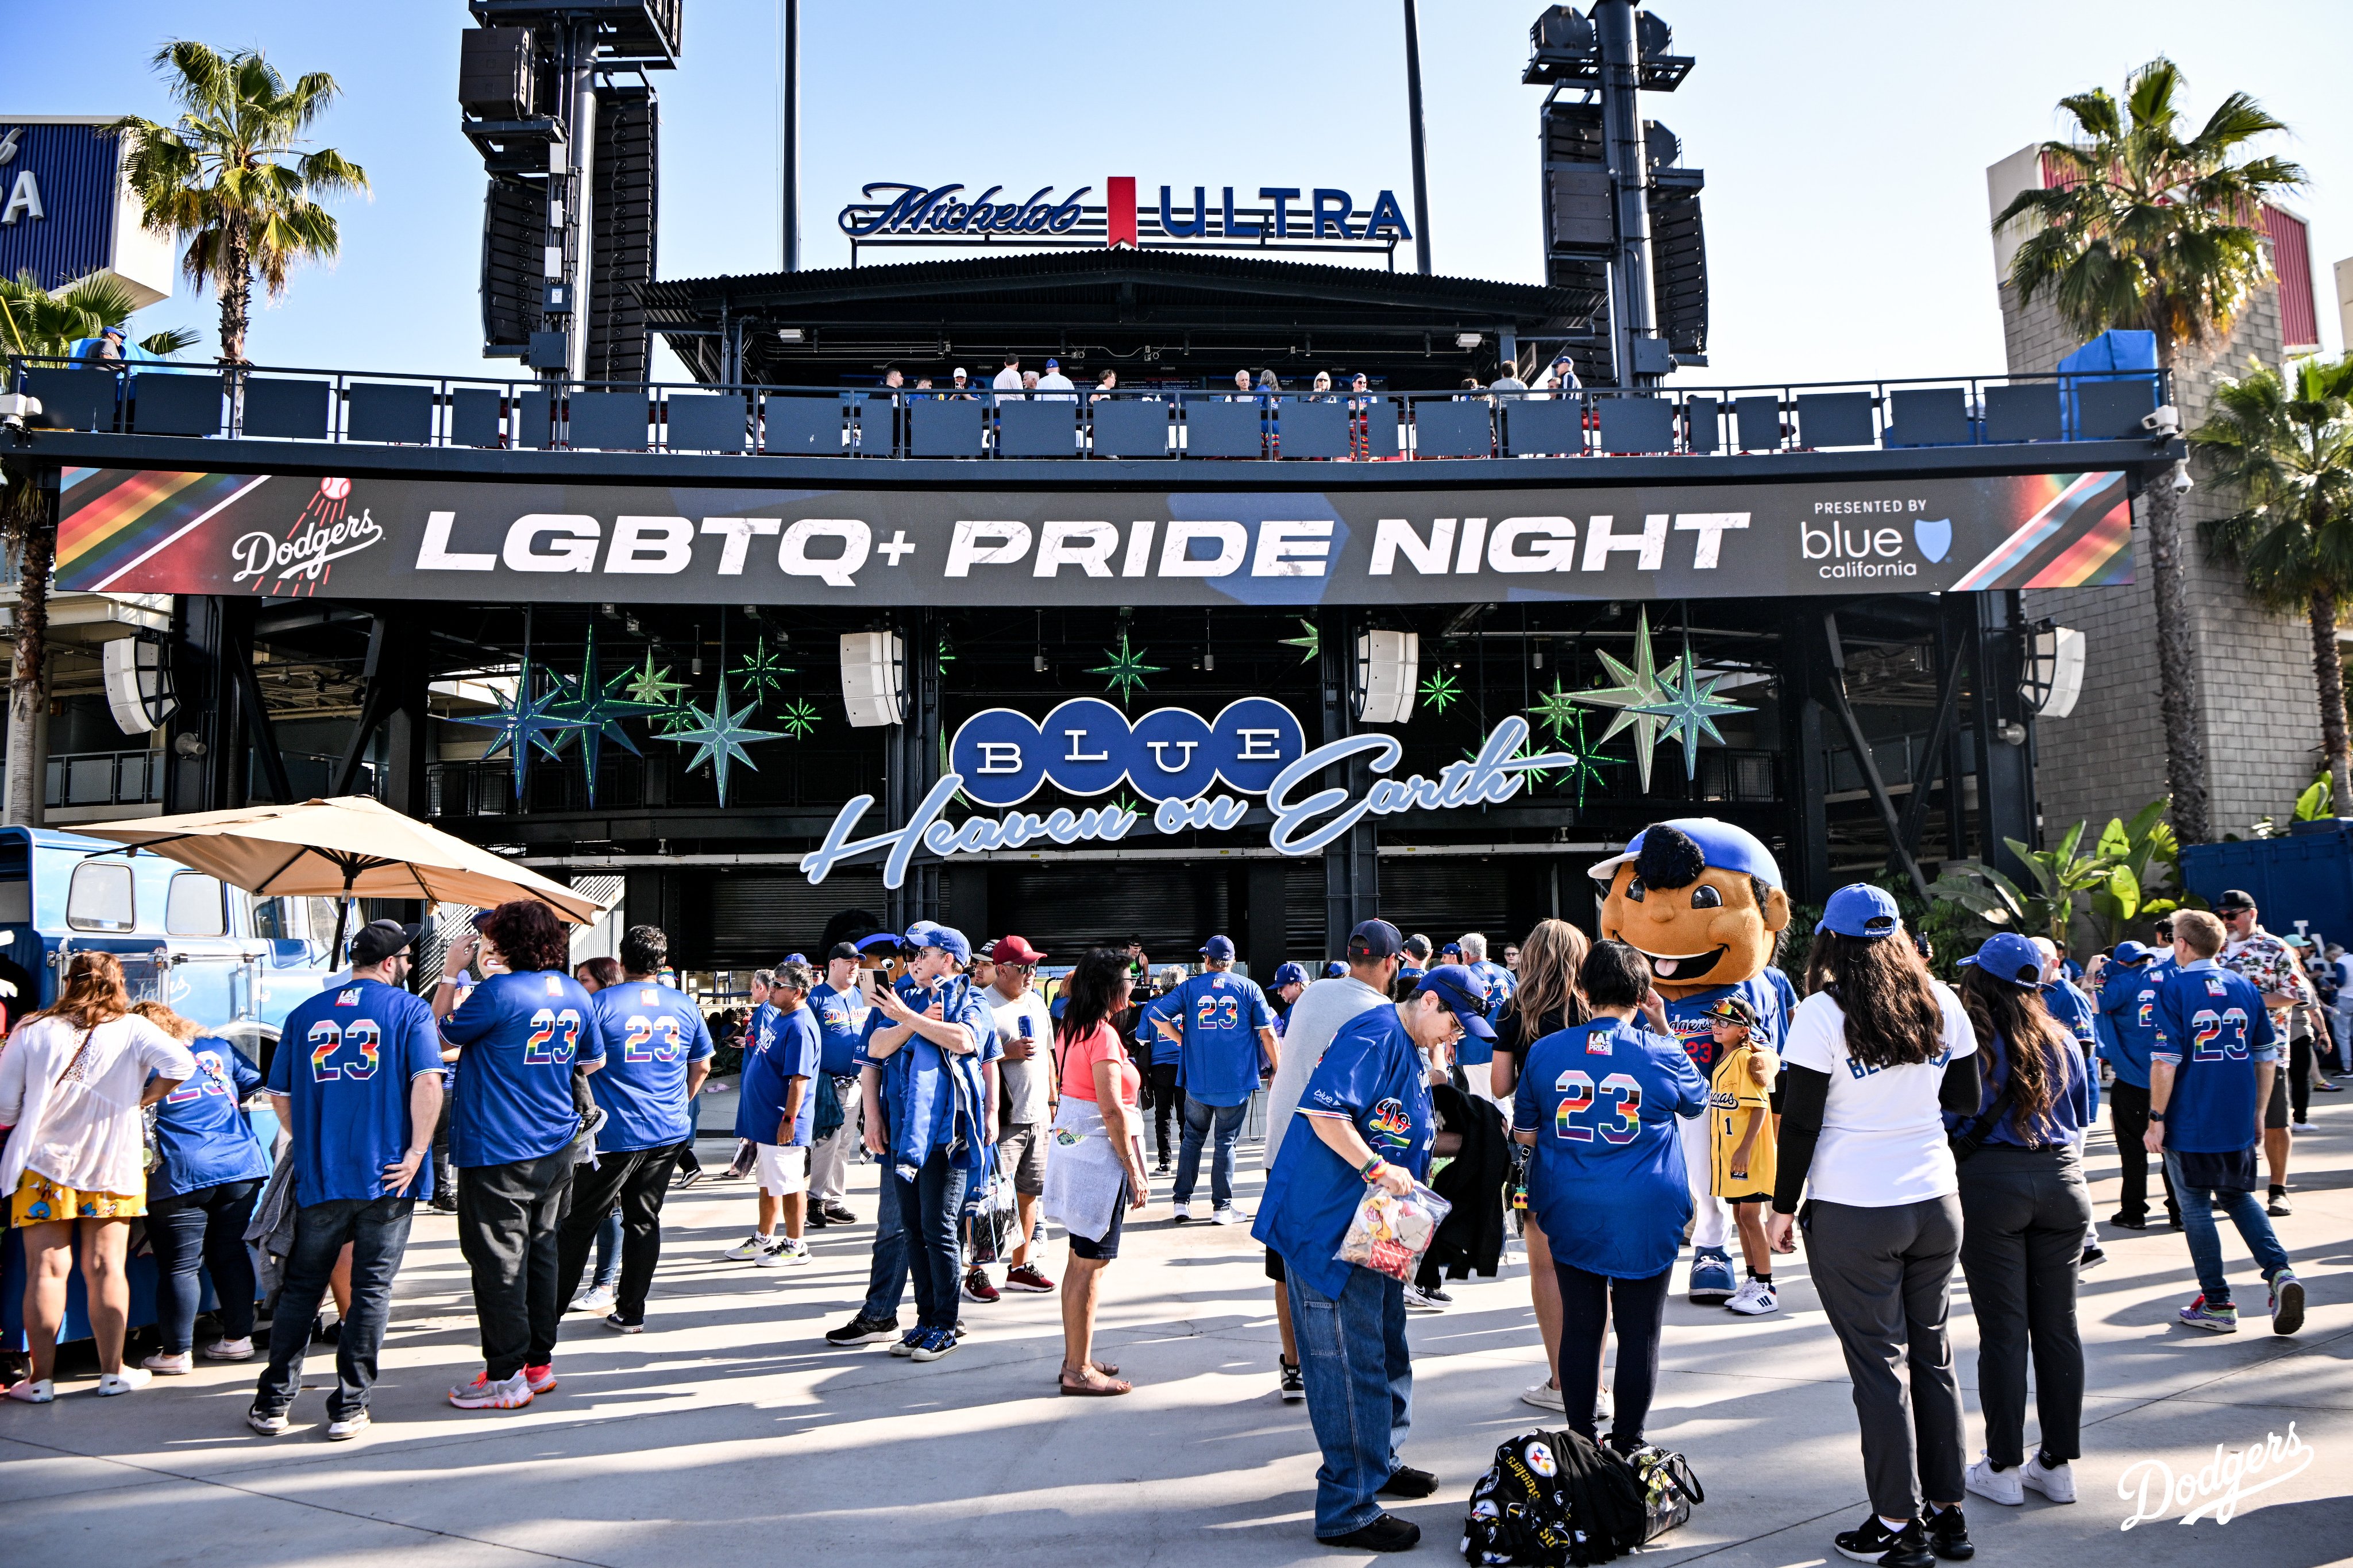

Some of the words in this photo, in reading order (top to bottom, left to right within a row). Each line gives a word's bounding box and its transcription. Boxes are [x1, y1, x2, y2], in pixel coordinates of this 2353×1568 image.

[0, 170, 44, 225] A
[838, 181, 1092, 237] Michelob
[1159, 185, 1413, 241] ULTRA
[1814, 500, 1903, 514] PRESENTED
[1908, 499, 1927, 512] BY
[232, 508, 383, 582] Dodgers
[415, 511, 916, 586] LGBTQ+
[944, 520, 1334, 577] PRIDE
[1368, 512, 1751, 575] NIGHT
[1801, 520, 1903, 559] blue
[1819, 559, 1917, 578] california
[977, 728, 1280, 774] BLUE
[800, 773, 1137, 889] Heaven
[1154, 794, 1249, 835] on
[1266, 715, 1578, 856] Earth
[1198, 995, 1237, 1029] 23
[2192, 1007, 2249, 1062] 23
[308, 1019, 381, 1083] 23
[524, 1009, 581, 1065] 23
[624, 1015, 680, 1062] 23
[1588, 1033, 1611, 1045] LA!
[1588, 1044, 1610, 1052] PRIDE
[1685, 1041, 1712, 1063] 23
[1314, 1088, 1333, 1104] blue
[1555, 1069, 1642, 1145] 23
[1725, 1117, 1734, 1136] 1
[1506, 1455, 1541, 1499] Steelers
